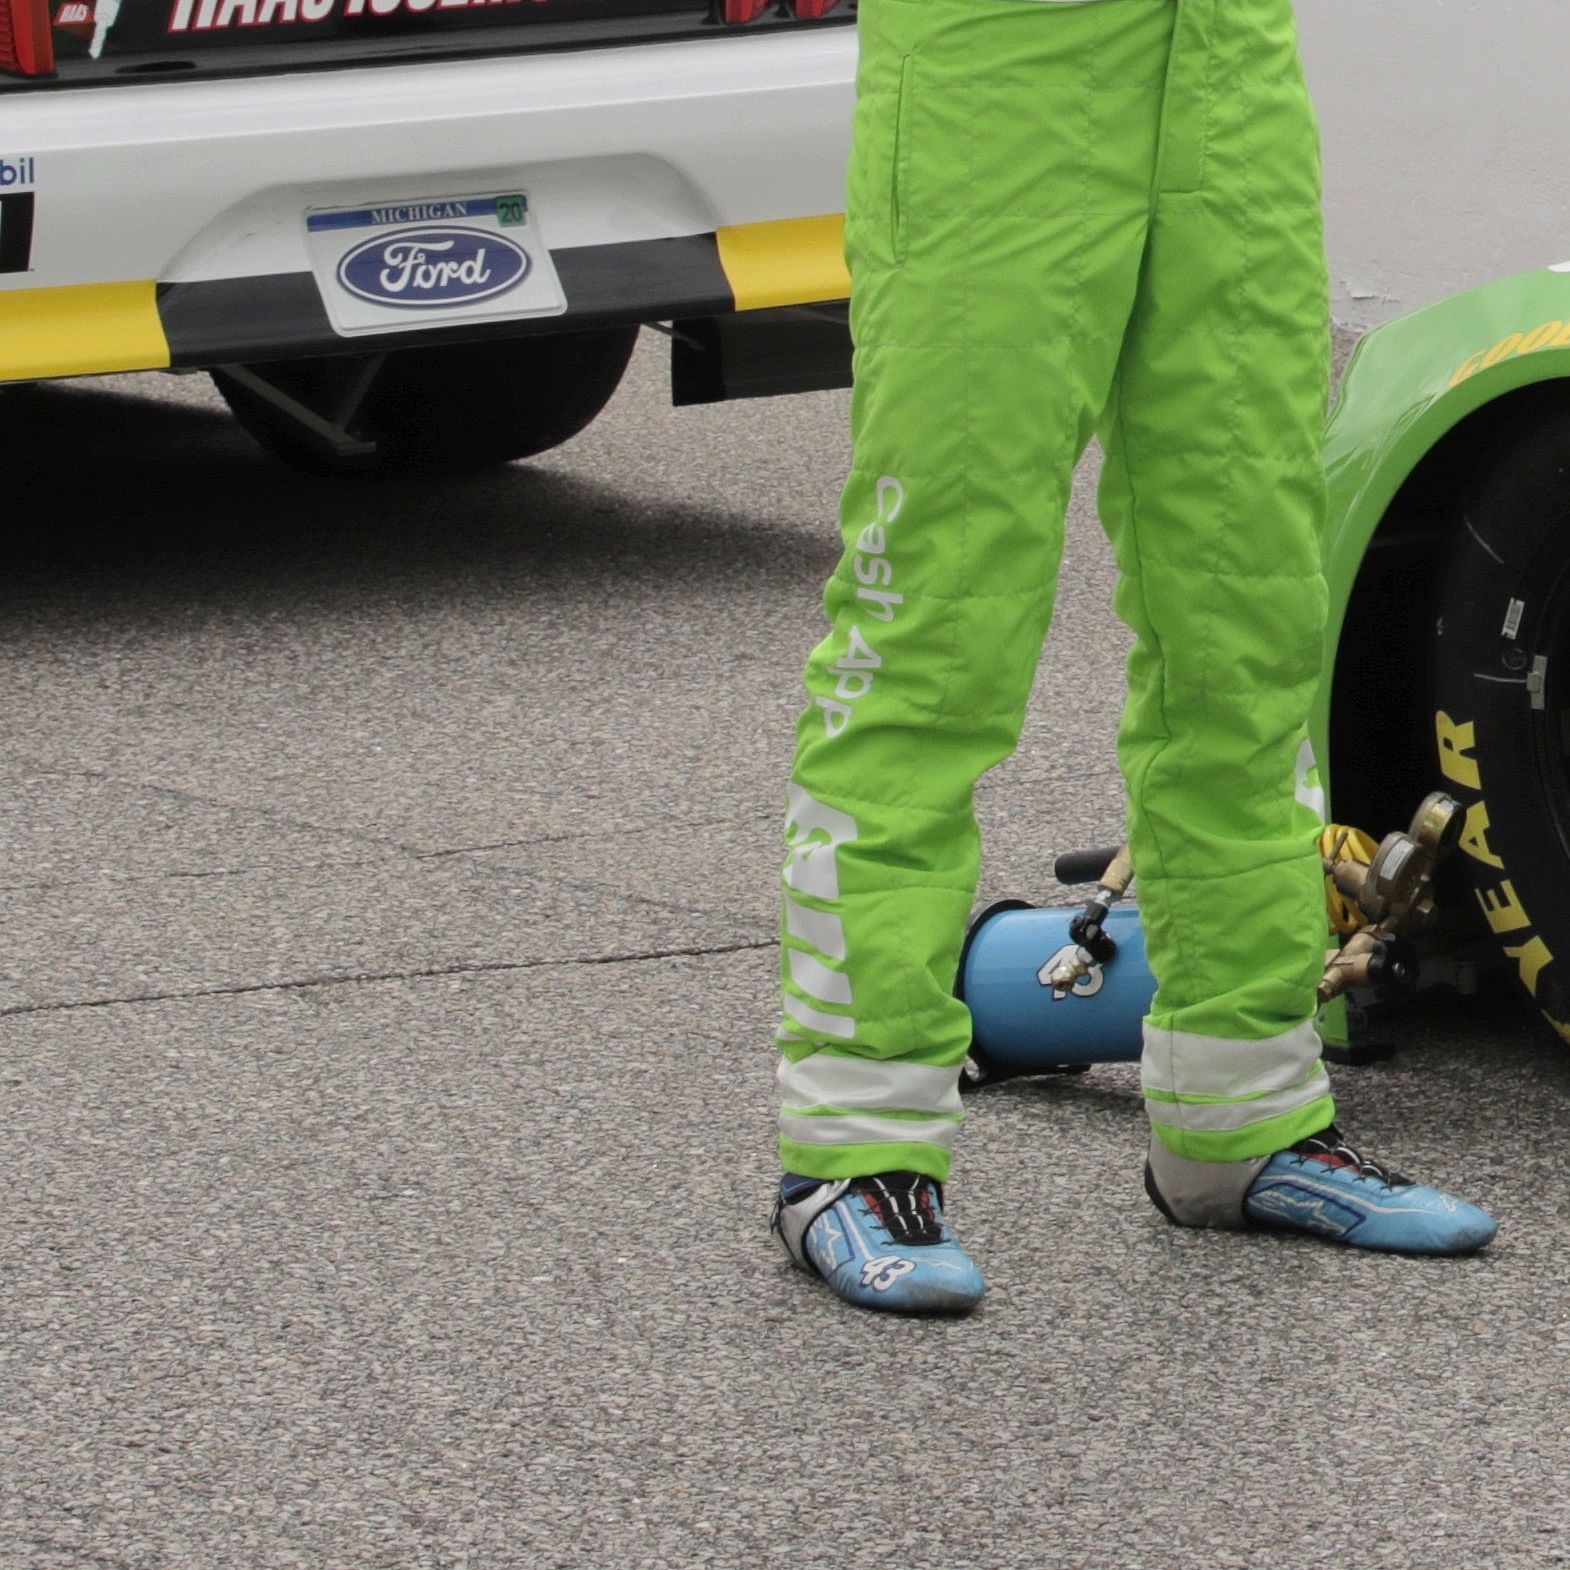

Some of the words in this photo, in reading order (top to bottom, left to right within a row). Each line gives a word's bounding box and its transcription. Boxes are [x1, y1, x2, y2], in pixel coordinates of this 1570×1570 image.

[371, 201, 469, 226] MICHIGAN
[379, 240, 493, 293] Ford
[853, 475, 905, 623] Cash
[813, 624, 884, 740] App
